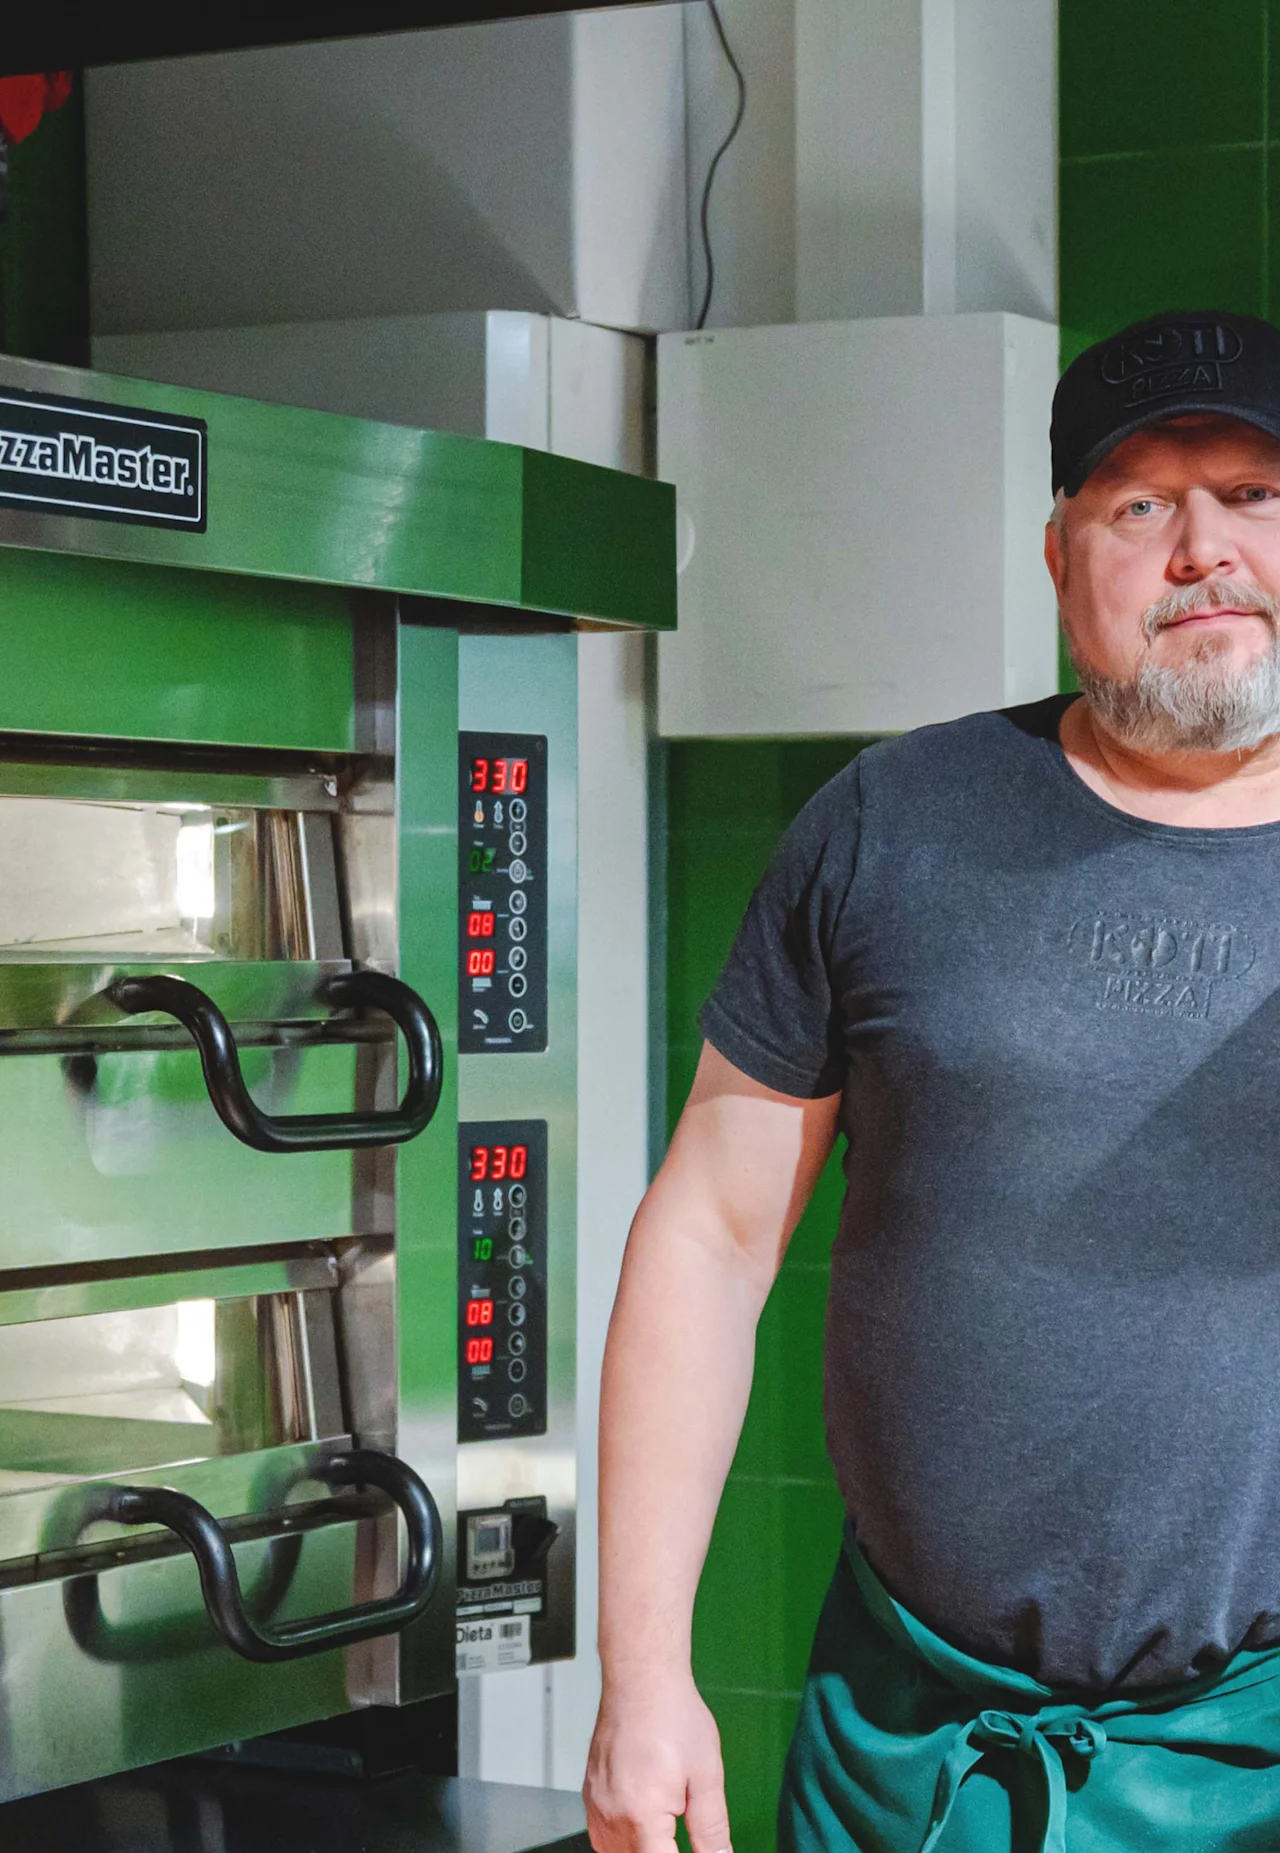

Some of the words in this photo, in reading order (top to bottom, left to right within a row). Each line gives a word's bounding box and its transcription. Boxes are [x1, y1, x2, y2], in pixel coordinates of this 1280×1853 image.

[472, 759, 528, 793] 330
[469, 912, 494, 936] 08
[469, 950, 494, 974] 00
[1103, 976, 1199, 1009] PIZZA
[472, 1145, 527, 1181] 330
[474, 1239, 493, 1260] 10
[467, 1301, 493, 1326] 08
[467, 1338, 493, 1363] 00
